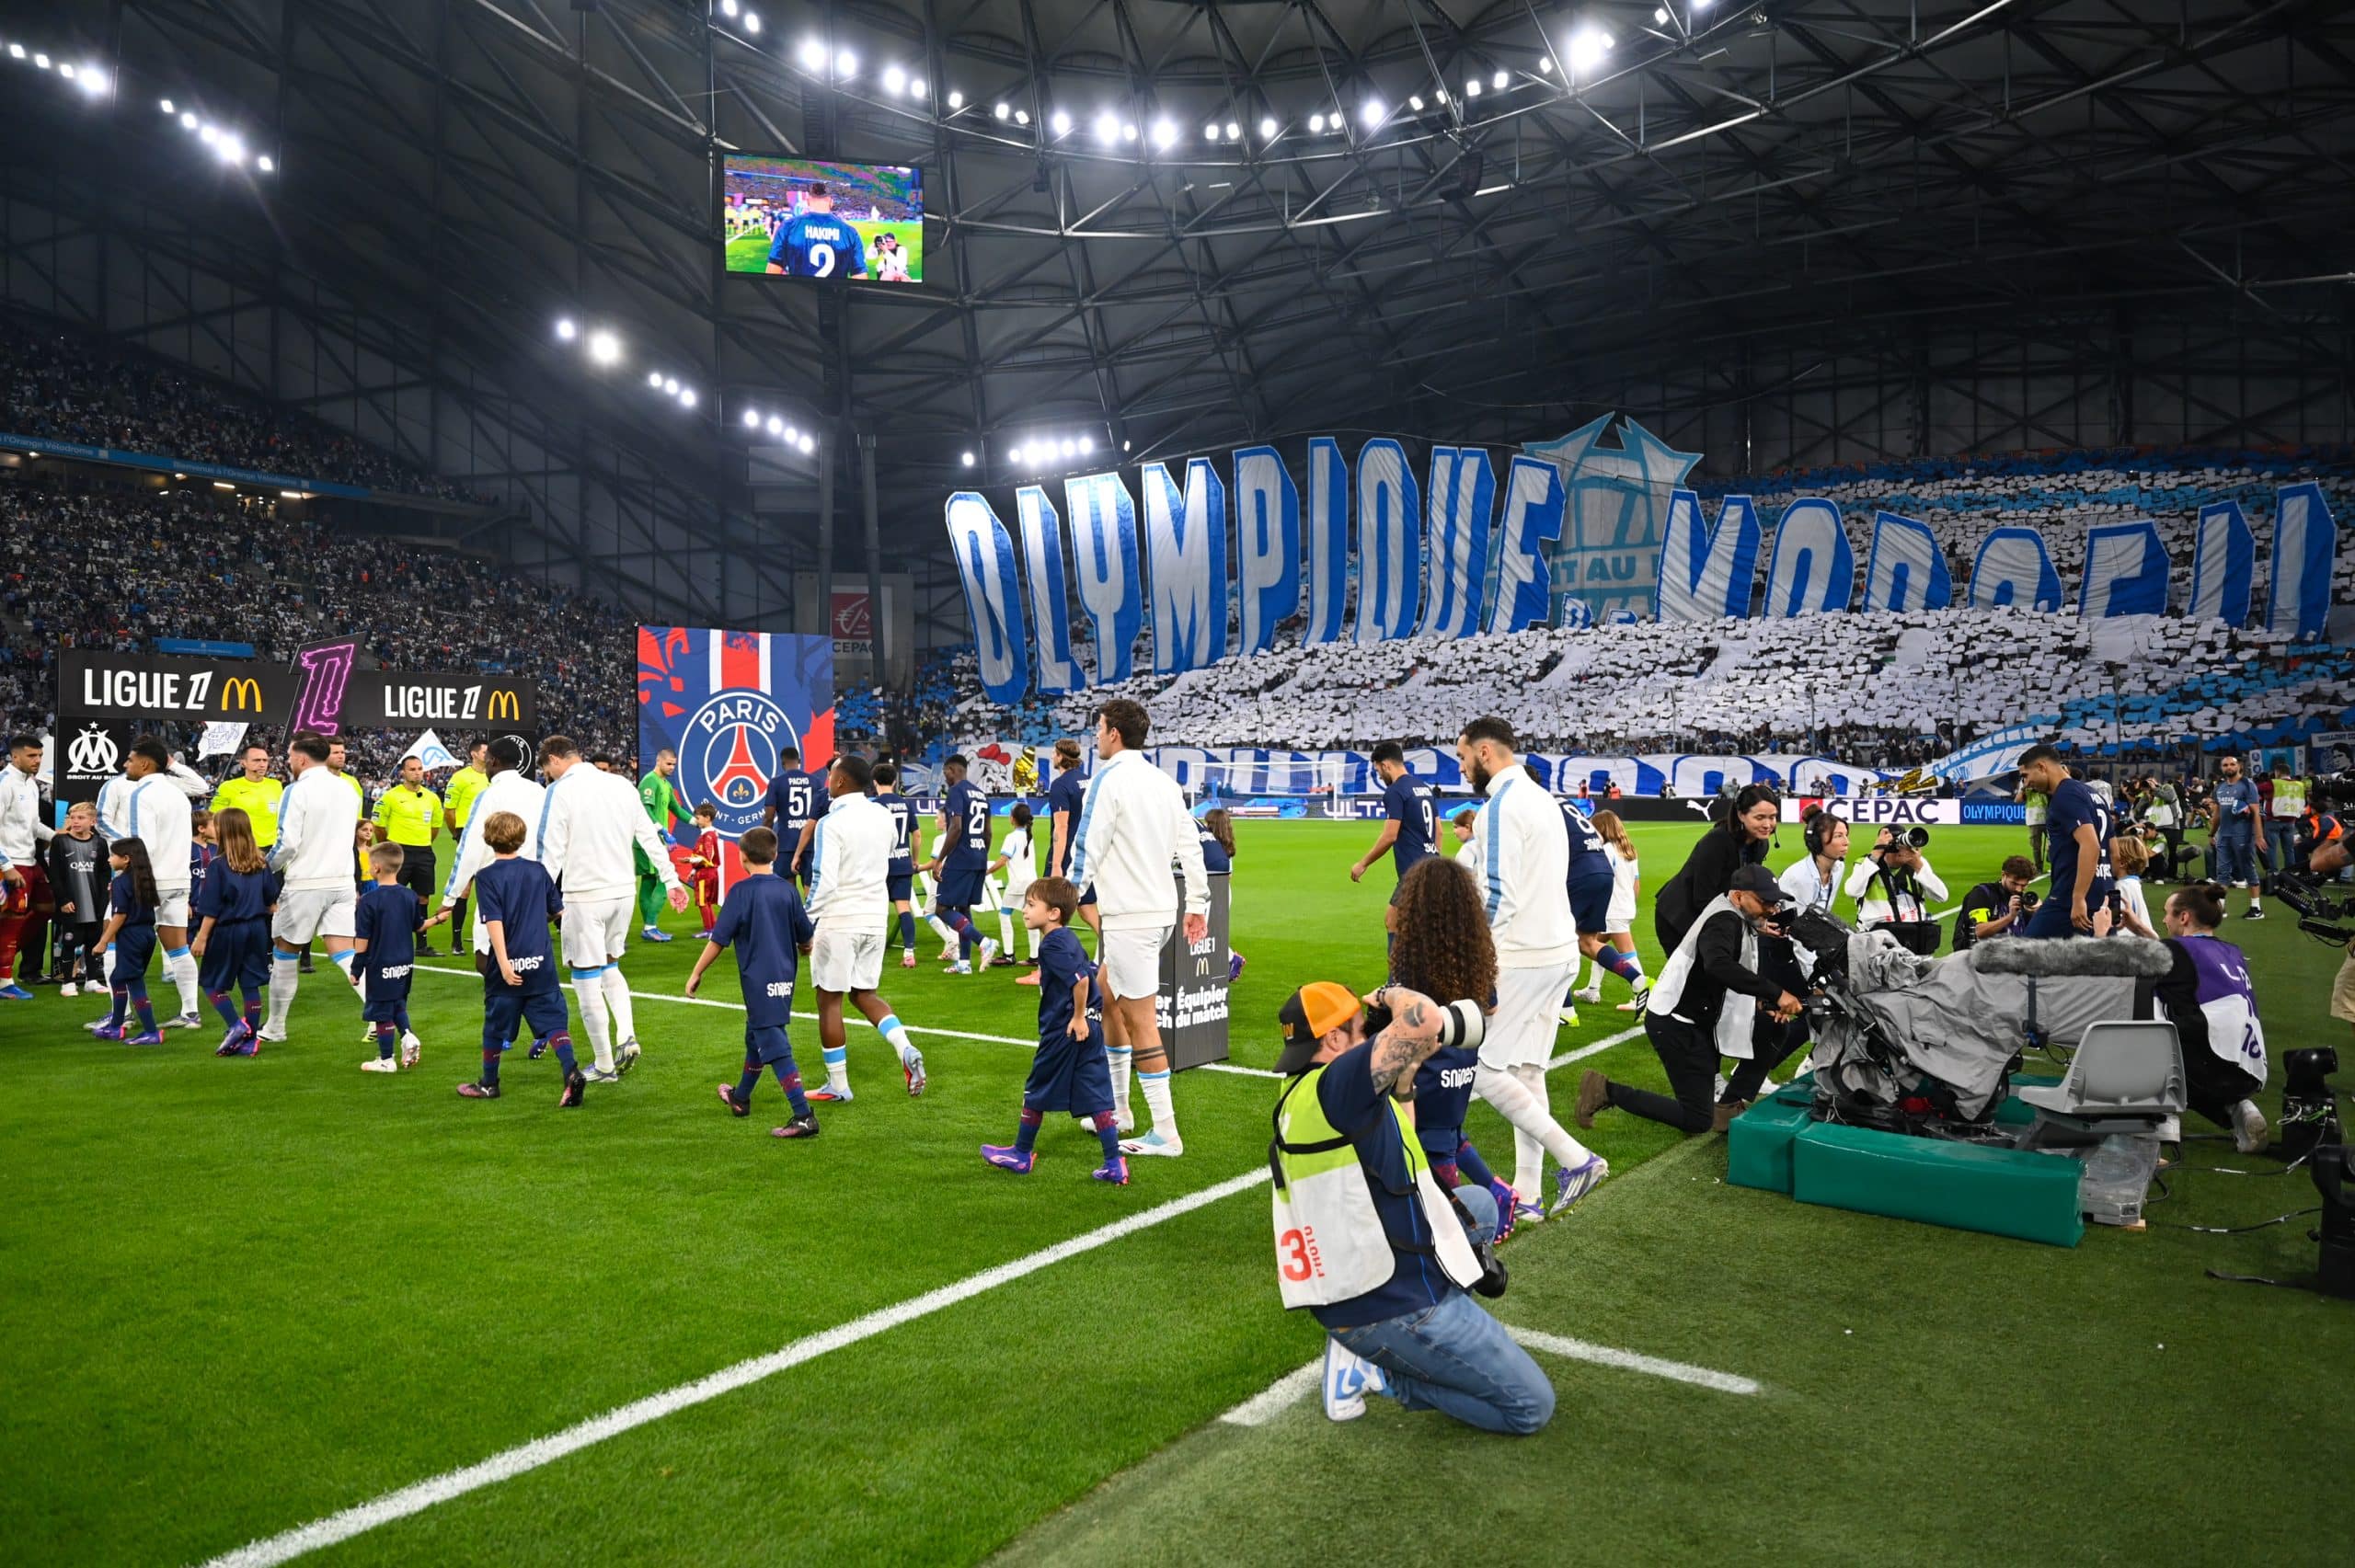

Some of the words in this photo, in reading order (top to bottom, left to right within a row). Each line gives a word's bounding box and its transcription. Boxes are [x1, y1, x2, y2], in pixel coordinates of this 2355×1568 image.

[805, 225, 840, 241] HAKIMI
[84, 669, 181, 709] LIGUE
[385, 685, 458, 718] LIGUE
[699, 700, 780, 733] PARIS
[789, 786, 812, 817] 51
[1826, 799, 1940, 823] CEPAC
[1421, 799, 1433, 839] 9
[1563, 804, 1596, 833] 8
[1177, 984, 1228, 1012] Équipier
[1175, 1011, 1190, 1028] du
[1192, 1002, 1228, 1025] match
[1281, 1229, 1312, 1281] 3
